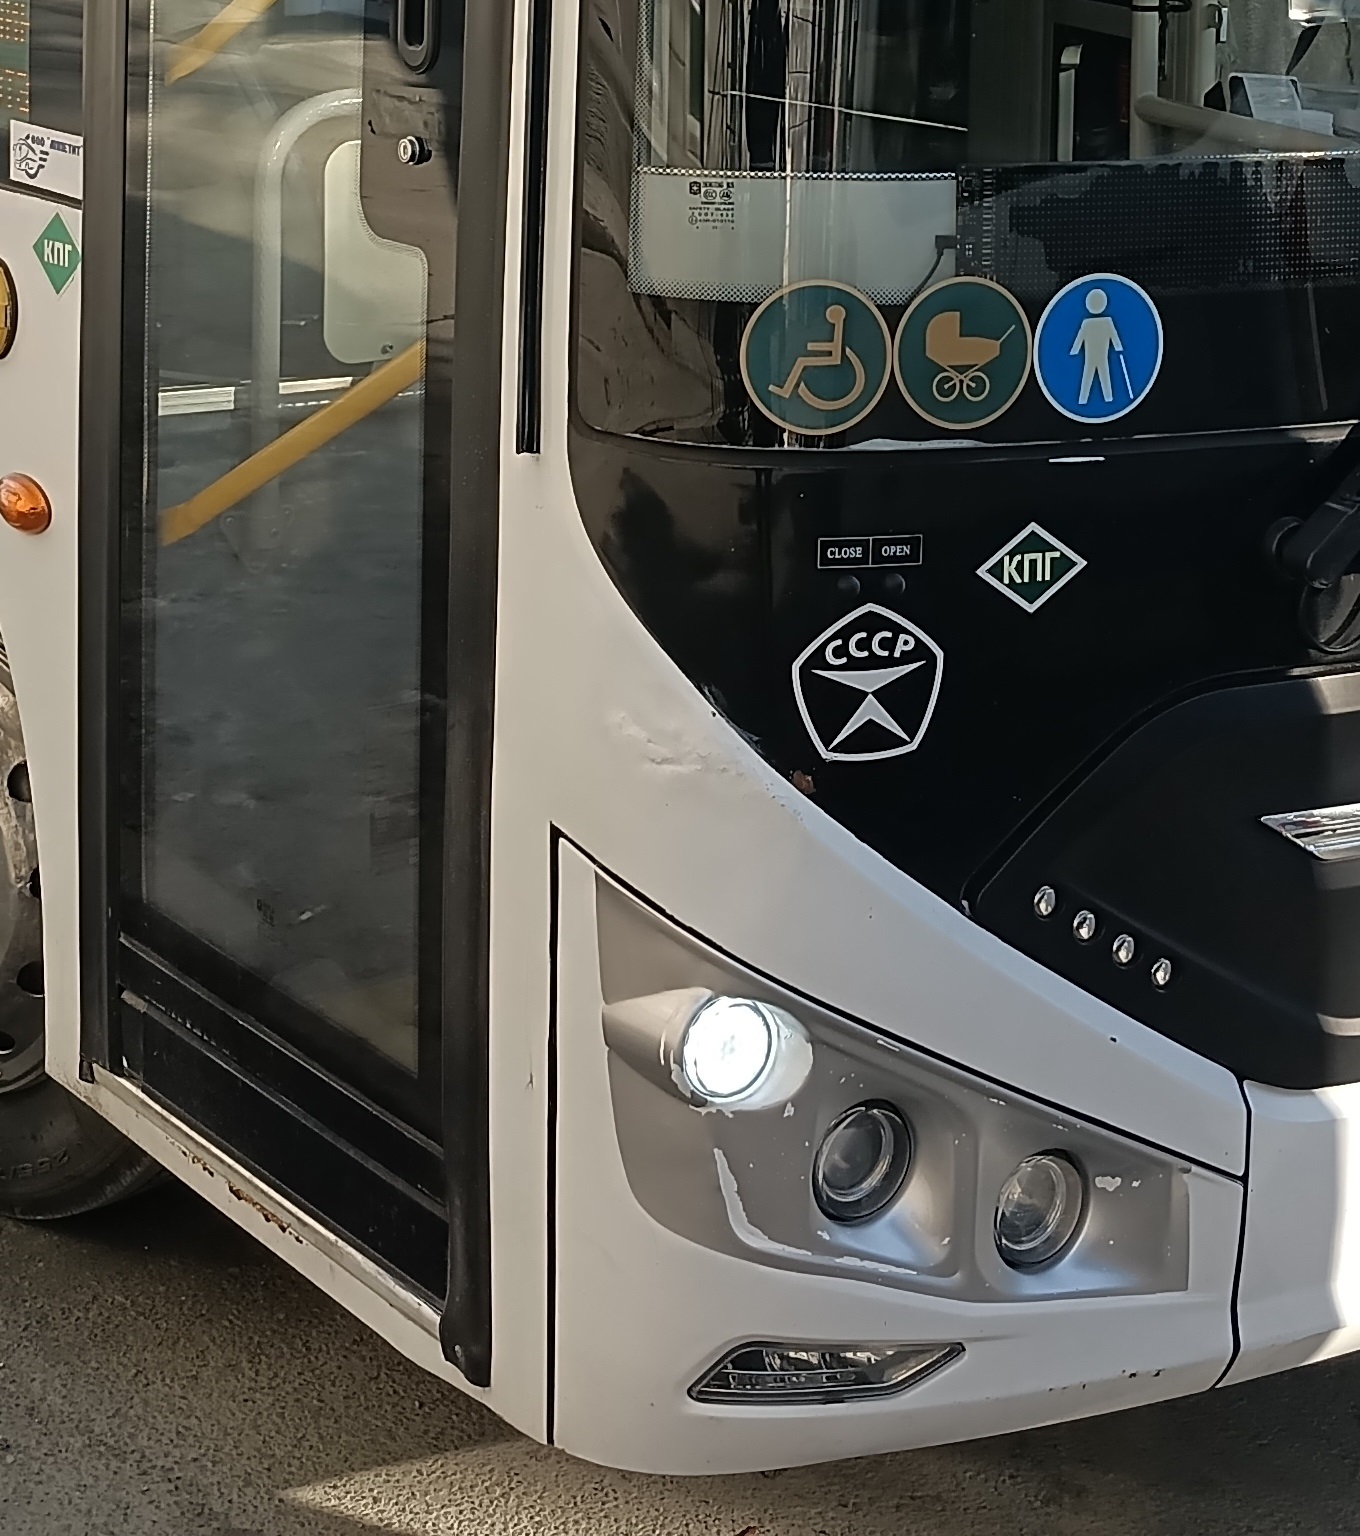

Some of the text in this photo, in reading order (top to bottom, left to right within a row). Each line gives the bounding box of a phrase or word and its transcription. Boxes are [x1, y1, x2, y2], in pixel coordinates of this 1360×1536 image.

[43, 239, 73, 268] КПГ
[826, 546, 863, 560] CLOSE
[881, 544, 911, 557] OPEN
[1002, 551, 1061, 585] КПГ
[824, 630, 916, 666] СССР
